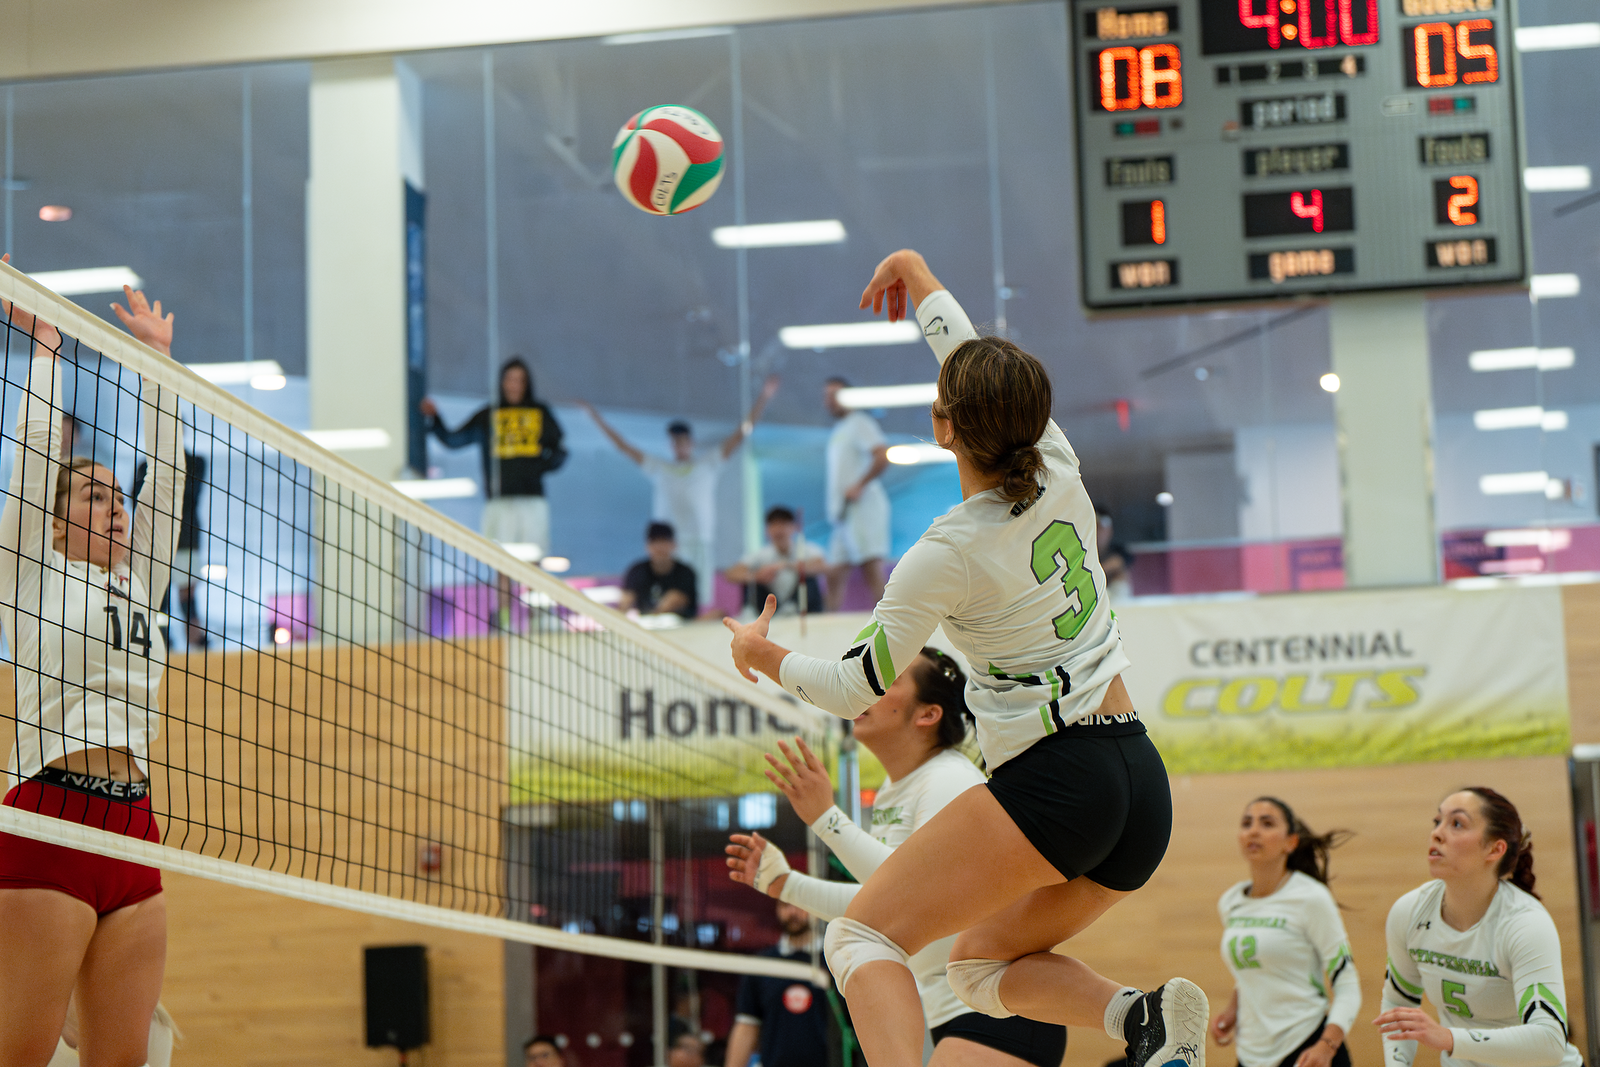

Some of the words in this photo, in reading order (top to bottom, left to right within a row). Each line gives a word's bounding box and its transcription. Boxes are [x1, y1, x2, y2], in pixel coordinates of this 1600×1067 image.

[1096, 6, 1169, 40] Home
[1340, 54, 1357, 79] 4
[1414, 18, 1499, 88] 05
[1099, 43, 1182, 112] 08
[1252, 90, 1336, 131] period
[1255, 144, 1339, 177] player
[1290, 189, 1324, 233] 4
[1448, 175, 1479, 227] 2
[1150, 200, 1166, 244] 1
[1268, 249, 1336, 284] game
[1435, 239, 1488, 268] won
[1118, 261, 1172, 289] won
[1029, 519, 1099, 642] 3
[103, 605, 153, 658] 14
[1188, 631, 1413, 667] CENTENNIAL
[1161, 665, 1429, 720] COLTS
[60, 773, 127, 798] NIKE
[1228, 935, 1261, 970] 12
[1441, 979, 1474, 1018] 5
